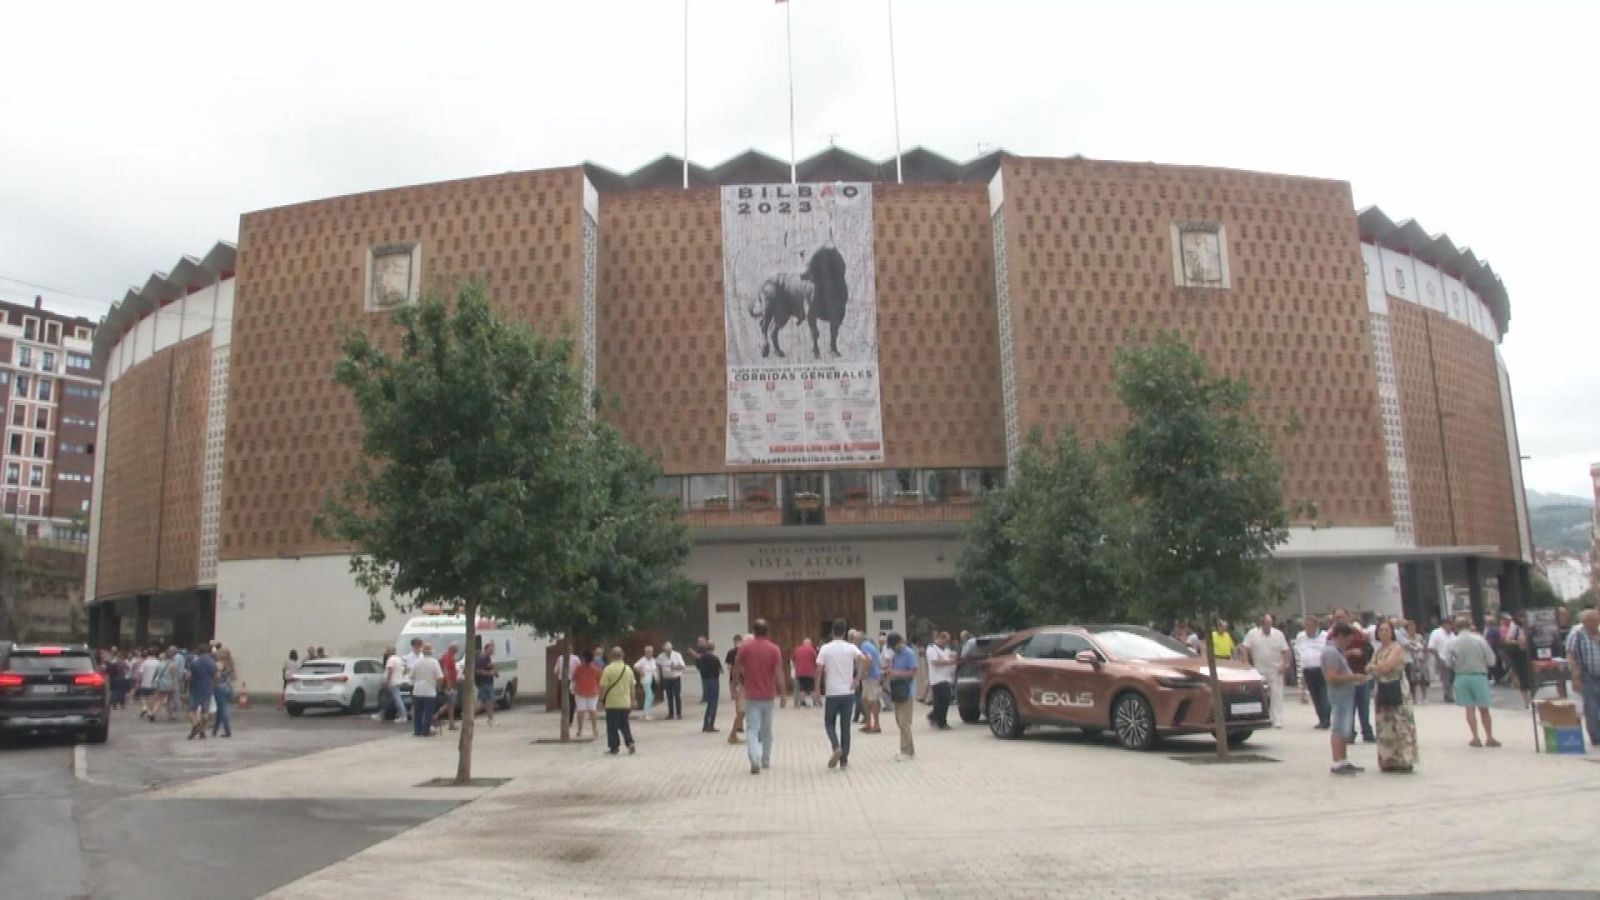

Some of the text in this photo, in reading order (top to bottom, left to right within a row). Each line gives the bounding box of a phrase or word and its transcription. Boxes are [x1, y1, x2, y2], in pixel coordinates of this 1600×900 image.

[738, 186, 859, 199] BILBAO
[737, 201, 812, 215] 2023
[734, 370, 873, 381] CORRIDAS GENERALES
[749, 555, 864, 569] VISTA ALEGRE
[1029, 690, 1095, 708] LEXUS
